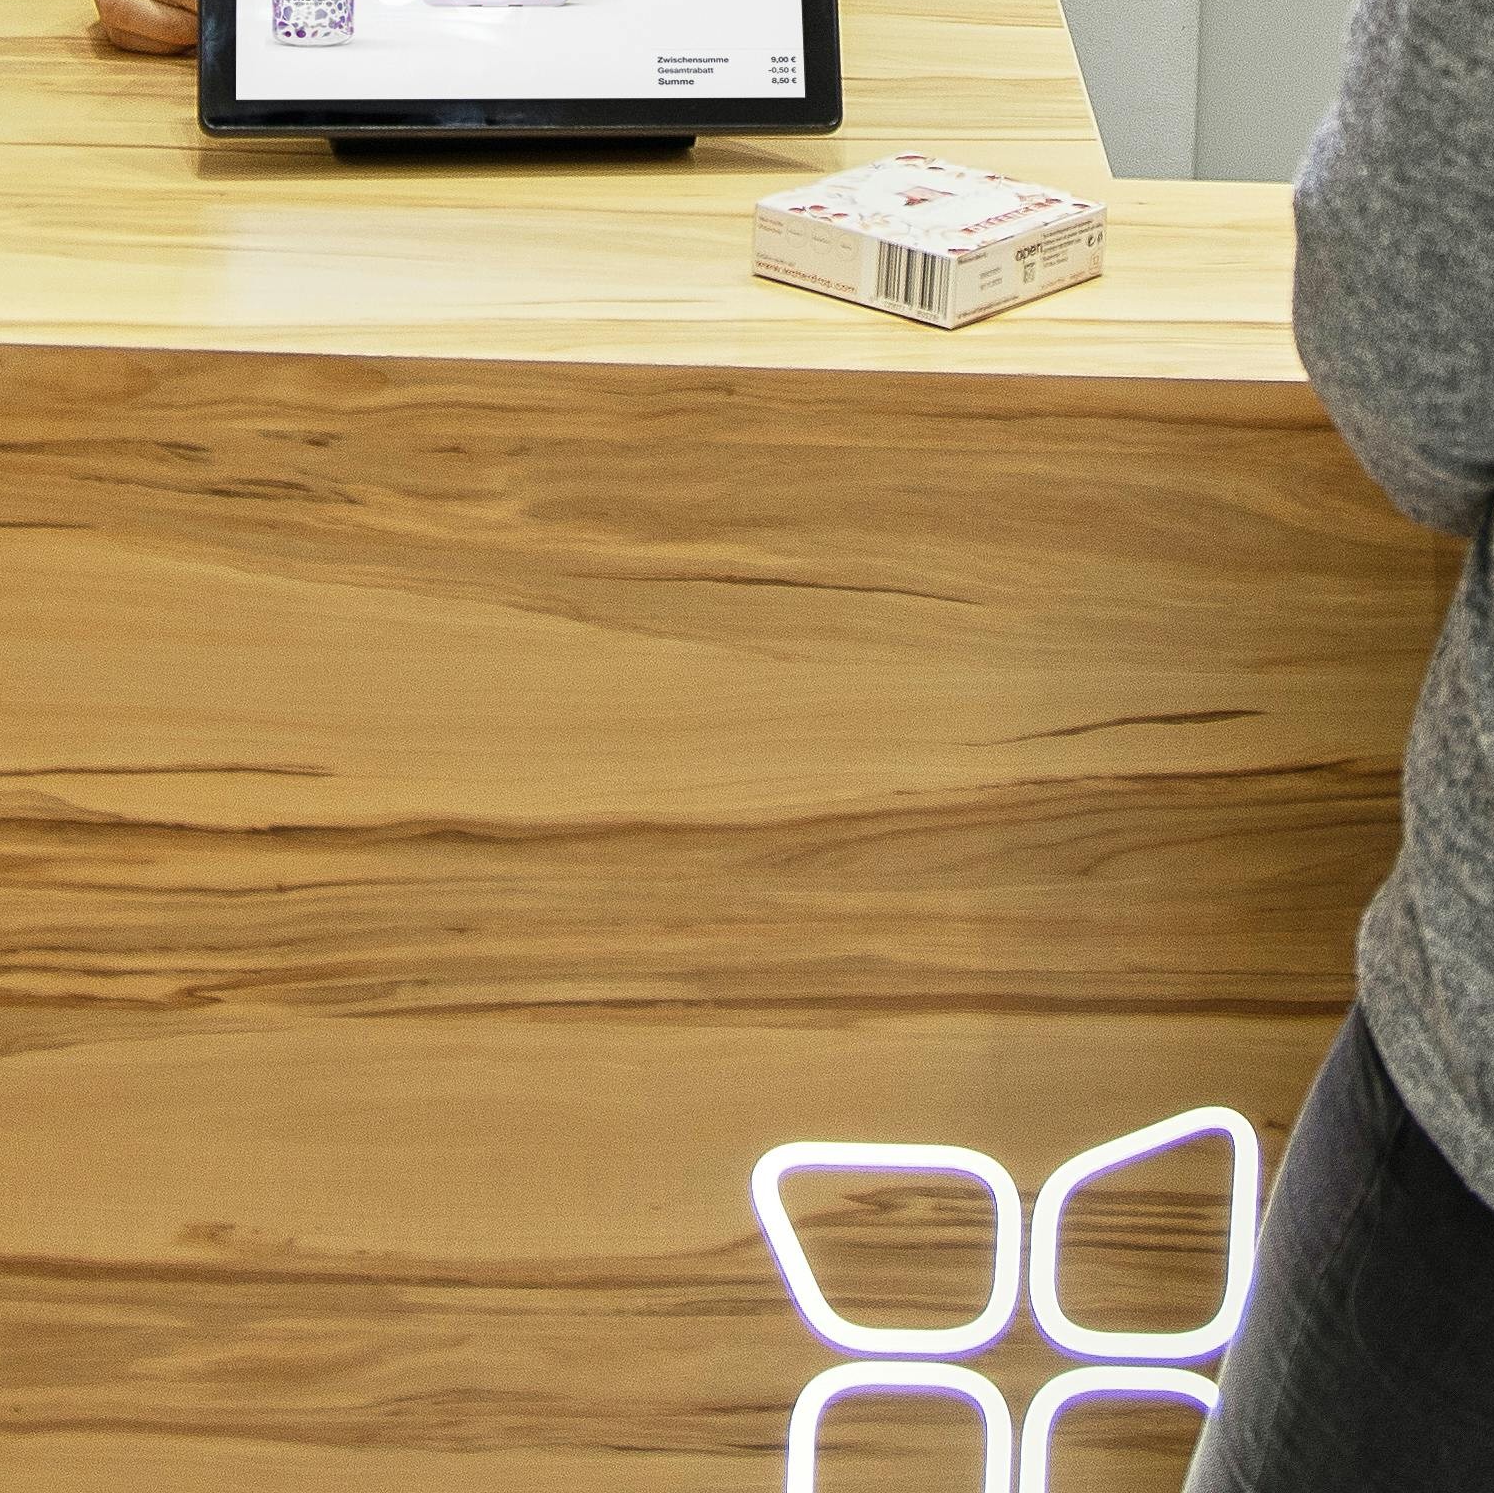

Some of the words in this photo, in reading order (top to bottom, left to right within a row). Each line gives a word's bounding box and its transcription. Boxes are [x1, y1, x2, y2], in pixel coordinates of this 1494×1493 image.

[657, 56, 729, 64] Zwischensumme
[770, 56, 789, 64] 9,00
[657, 66, 714, 74] Gesamtrabatt
[658, 77, 695, 86] Summe
[771, 77, 790, 85] 8,50
